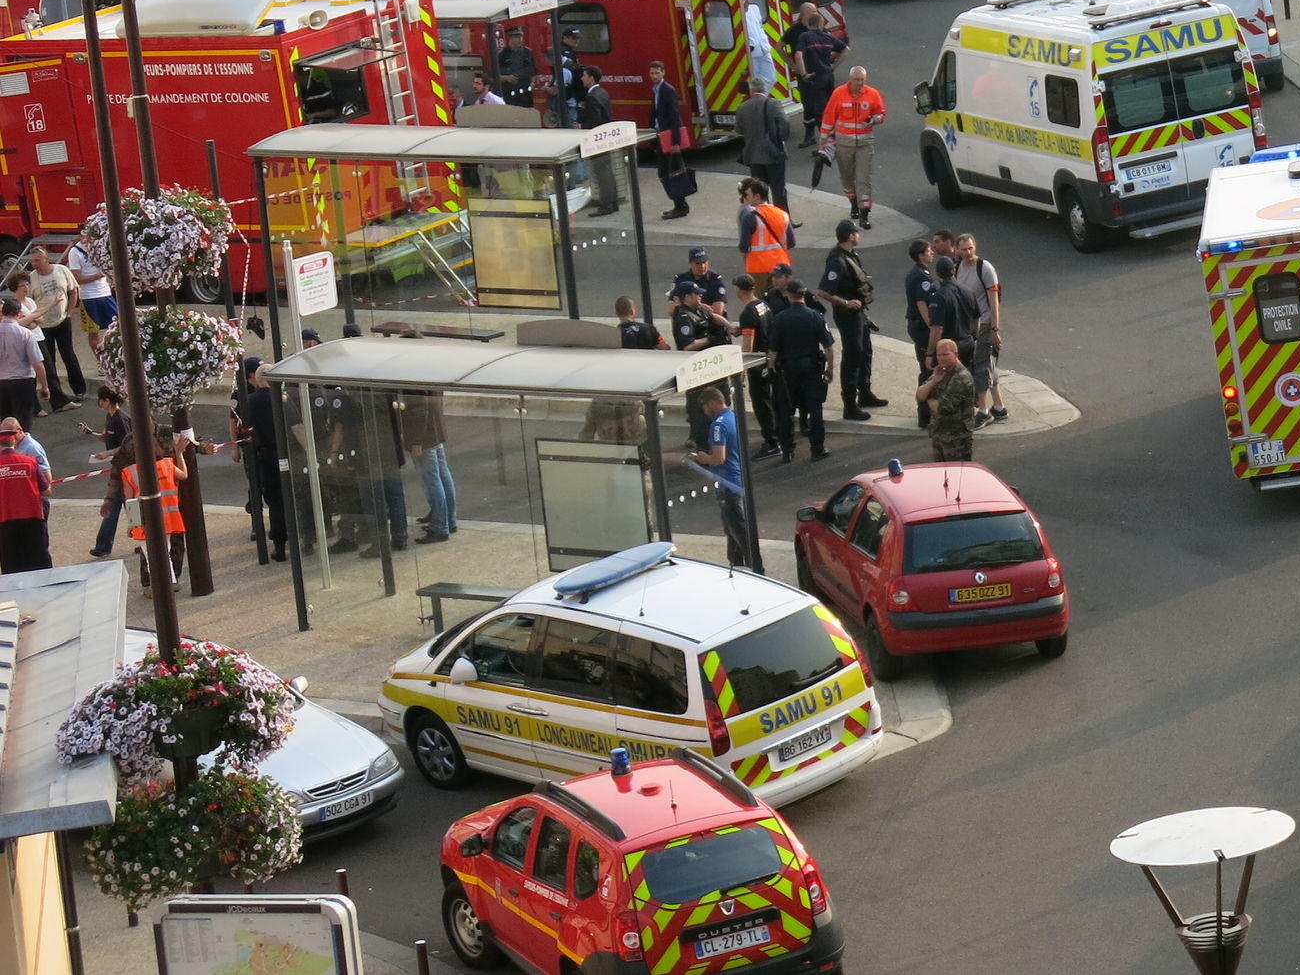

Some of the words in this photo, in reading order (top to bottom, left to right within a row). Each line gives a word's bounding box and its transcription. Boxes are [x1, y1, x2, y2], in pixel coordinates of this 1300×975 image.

[1104, 18, 1224, 64] SAMU
[1007, 34, 1073, 67] SAMU
[203, 63, 214, 75] DE
[215, 62, 254, 75] L'ESSONNE
[116, 93, 127, 104] DE
[211, 93, 222, 104] DE
[227, 92, 270, 104] COLONNE
[1030, 101, 1040, 116] 15
[30, 119, 43, 131] 18
[593, 128, 621, 142] 227-02
[1151, 175, 1171, 185] Petit
[1262, 303, 1299, 320] PROTECTION
[1273, 318, 1293, 332] CIVILE
[692, 354, 724, 372] 227-03
[1261, 441, 1273, 452] CJ
[957, 588, 978, 601] 635
[998, 585, 1009, 596] 91
[760, 692, 819, 734] SAMU
[821, 680, 842, 707] 91
[456, 705, 500, 731] SAMU
[502, 715, 522, 737] 91
[536, 722, 613, 755] LONGJUMEAU
[325, 804, 342, 817] 502
[344, 798, 360, 811] CGA
[360, 792, 372, 804] 91
[226, 905, 266, 914] JCDecaux
[697, 918, 765, 939] DUSTER
[704, 933, 761, 954] CL-279-TL
